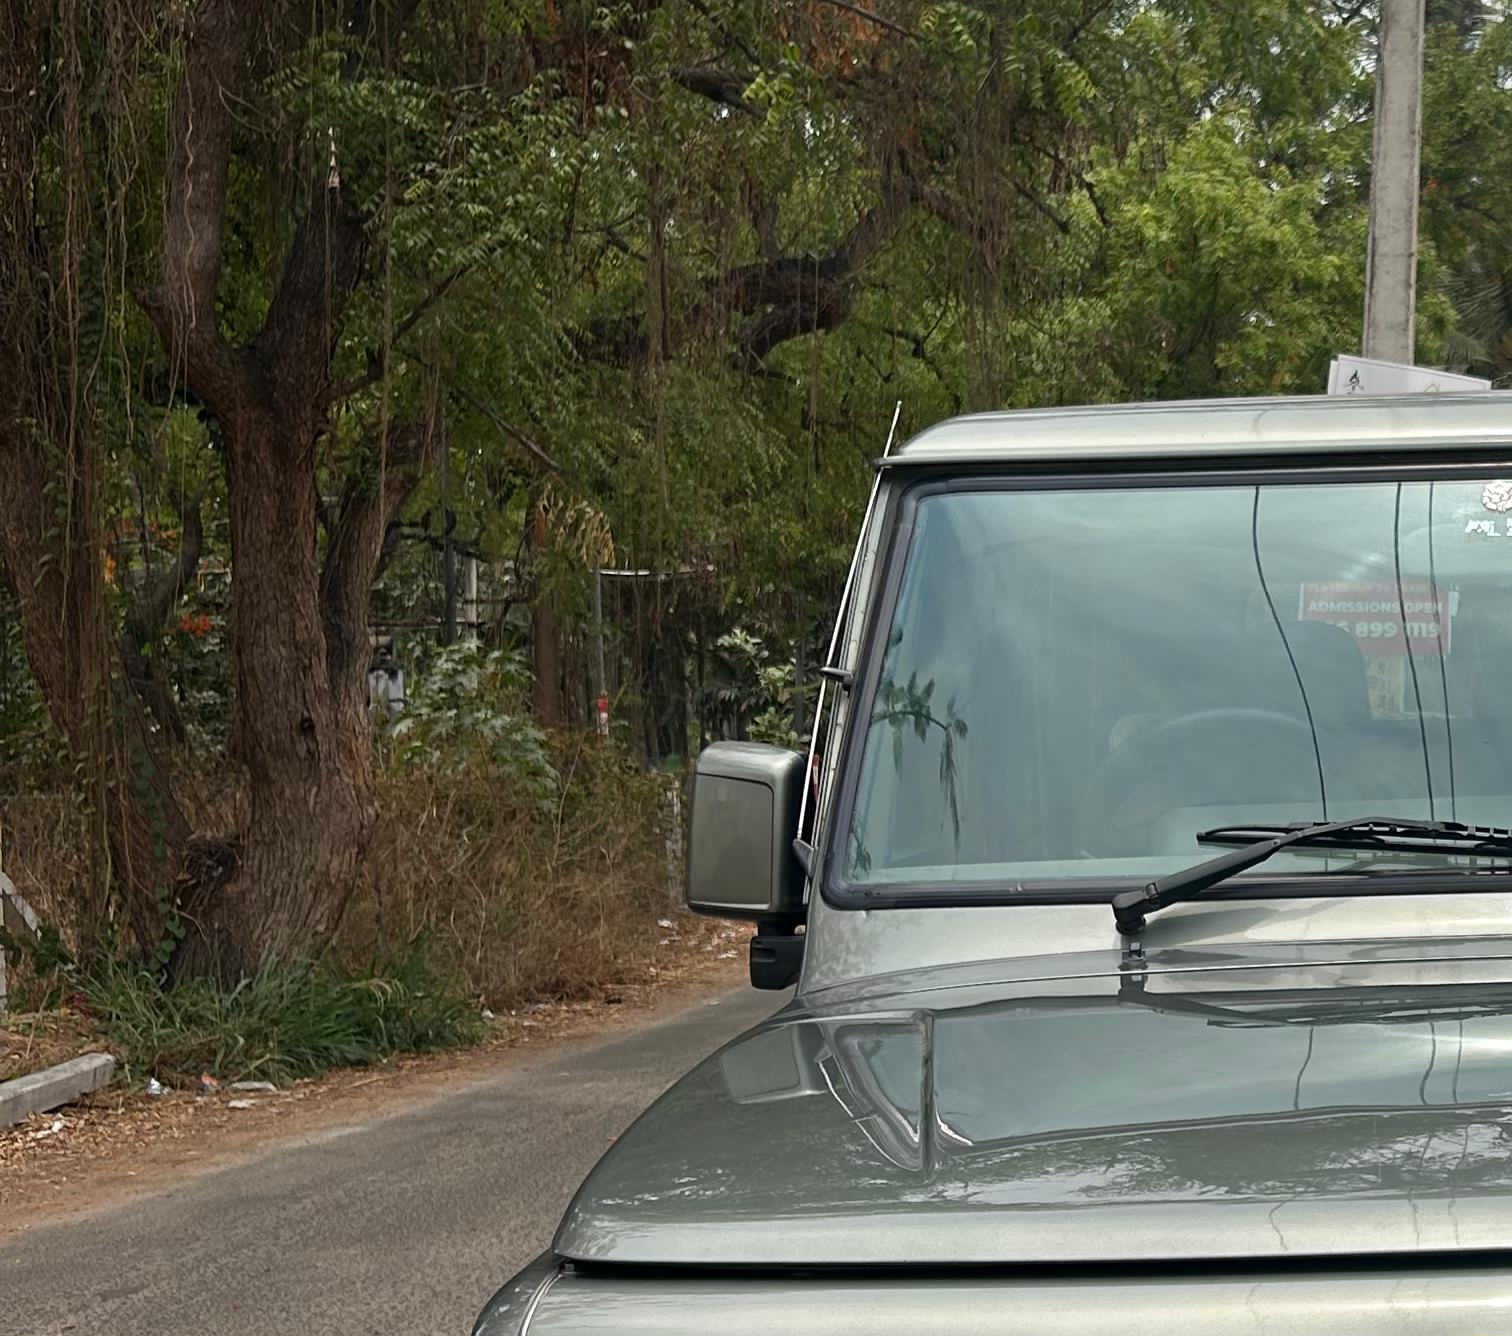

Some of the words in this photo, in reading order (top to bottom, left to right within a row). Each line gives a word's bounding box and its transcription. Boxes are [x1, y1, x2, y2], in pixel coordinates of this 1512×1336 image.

[1308, 600, 1401, 613] ADMISSIONS
[1404, 601, 1443, 614] OPEN
[1354, 621, 1398, 638] 899
